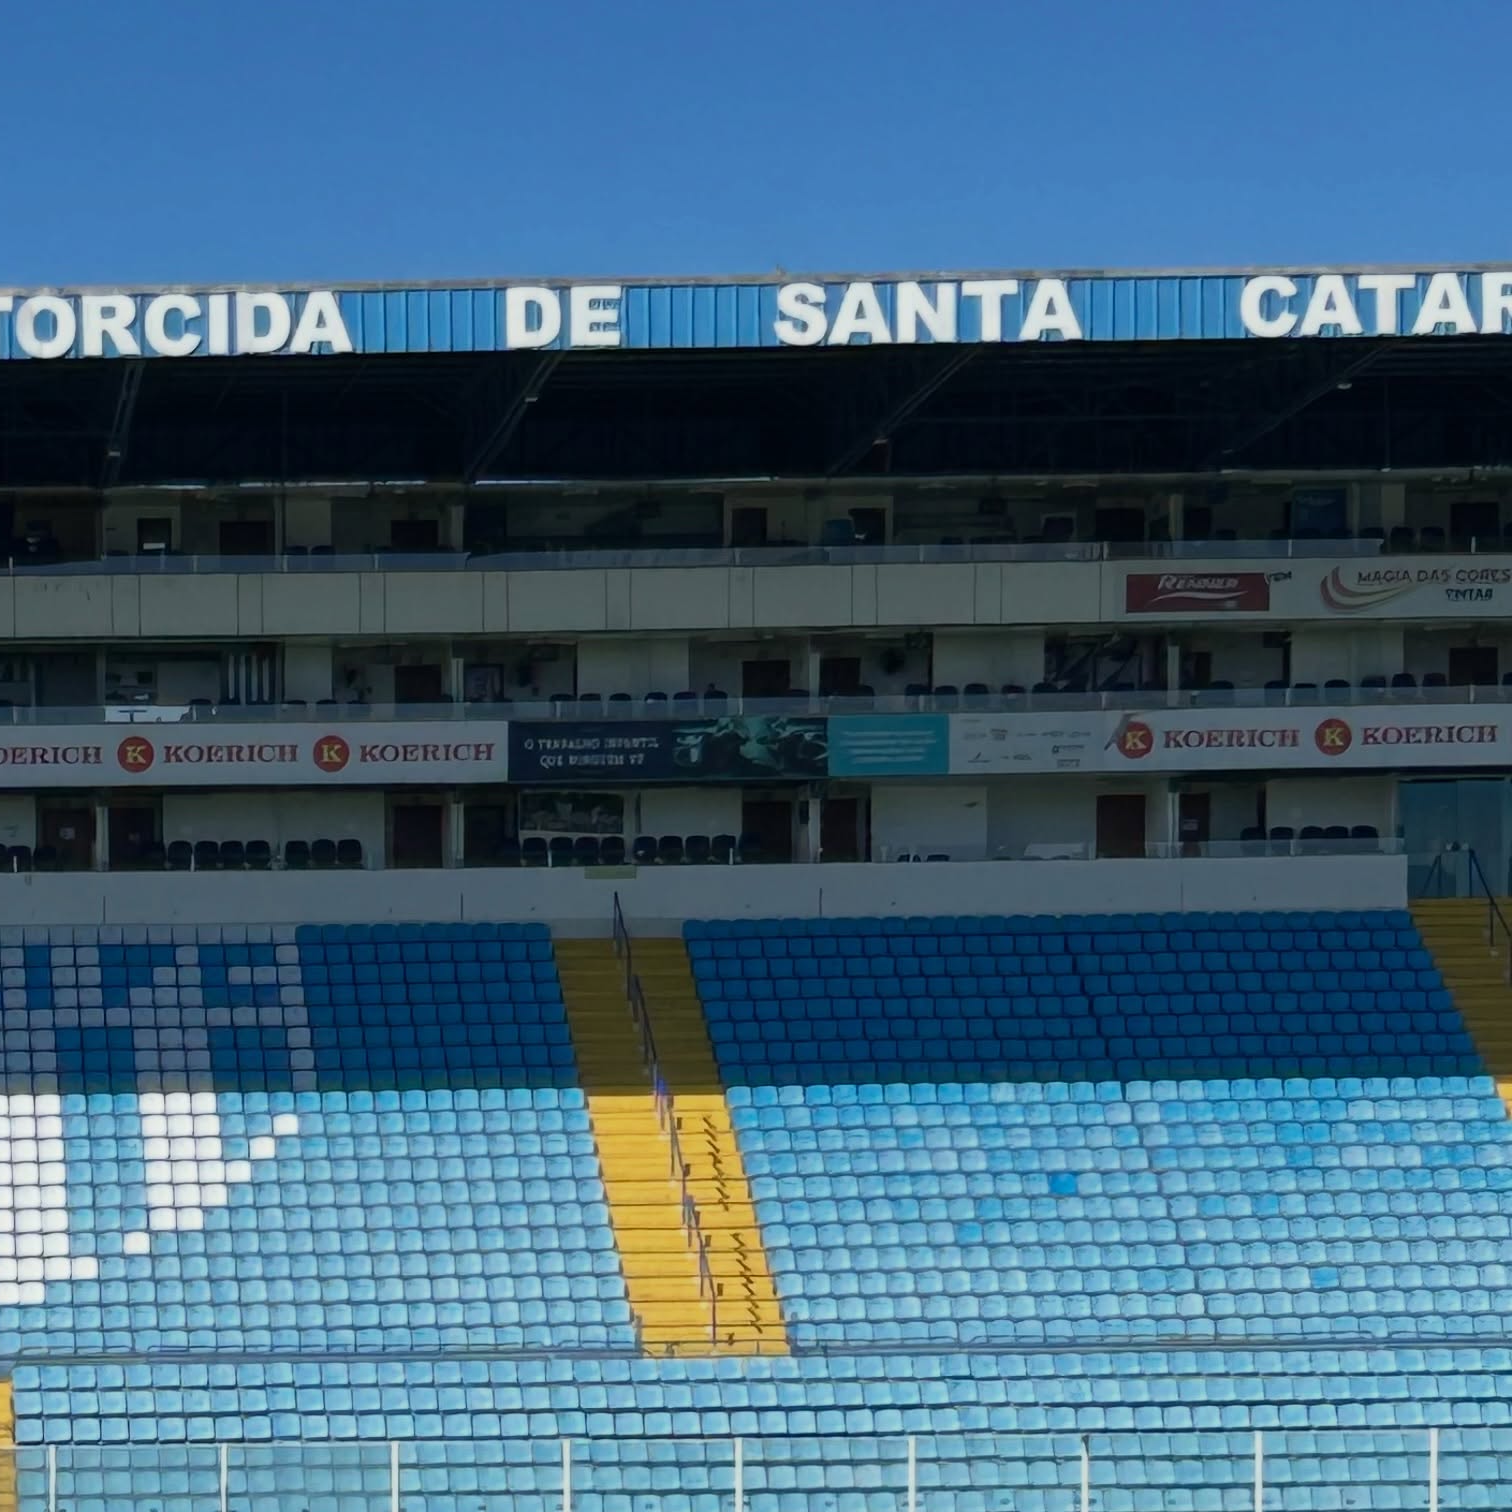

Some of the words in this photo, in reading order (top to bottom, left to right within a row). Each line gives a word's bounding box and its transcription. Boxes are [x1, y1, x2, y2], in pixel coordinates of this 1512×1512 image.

[505, 284, 622, 348] DE
[774, 278, 1084, 346] SANTA
[1357, 569, 1412, 585] MAGIA
[1417, 569, 1451, 584] DAS
[1163, 728, 1300, 749] KOERICH
[1361, 724, 1499, 745] KOERICH
[163, 744, 299, 764] KOERICH
[360, 743, 496, 763] KOERICH
